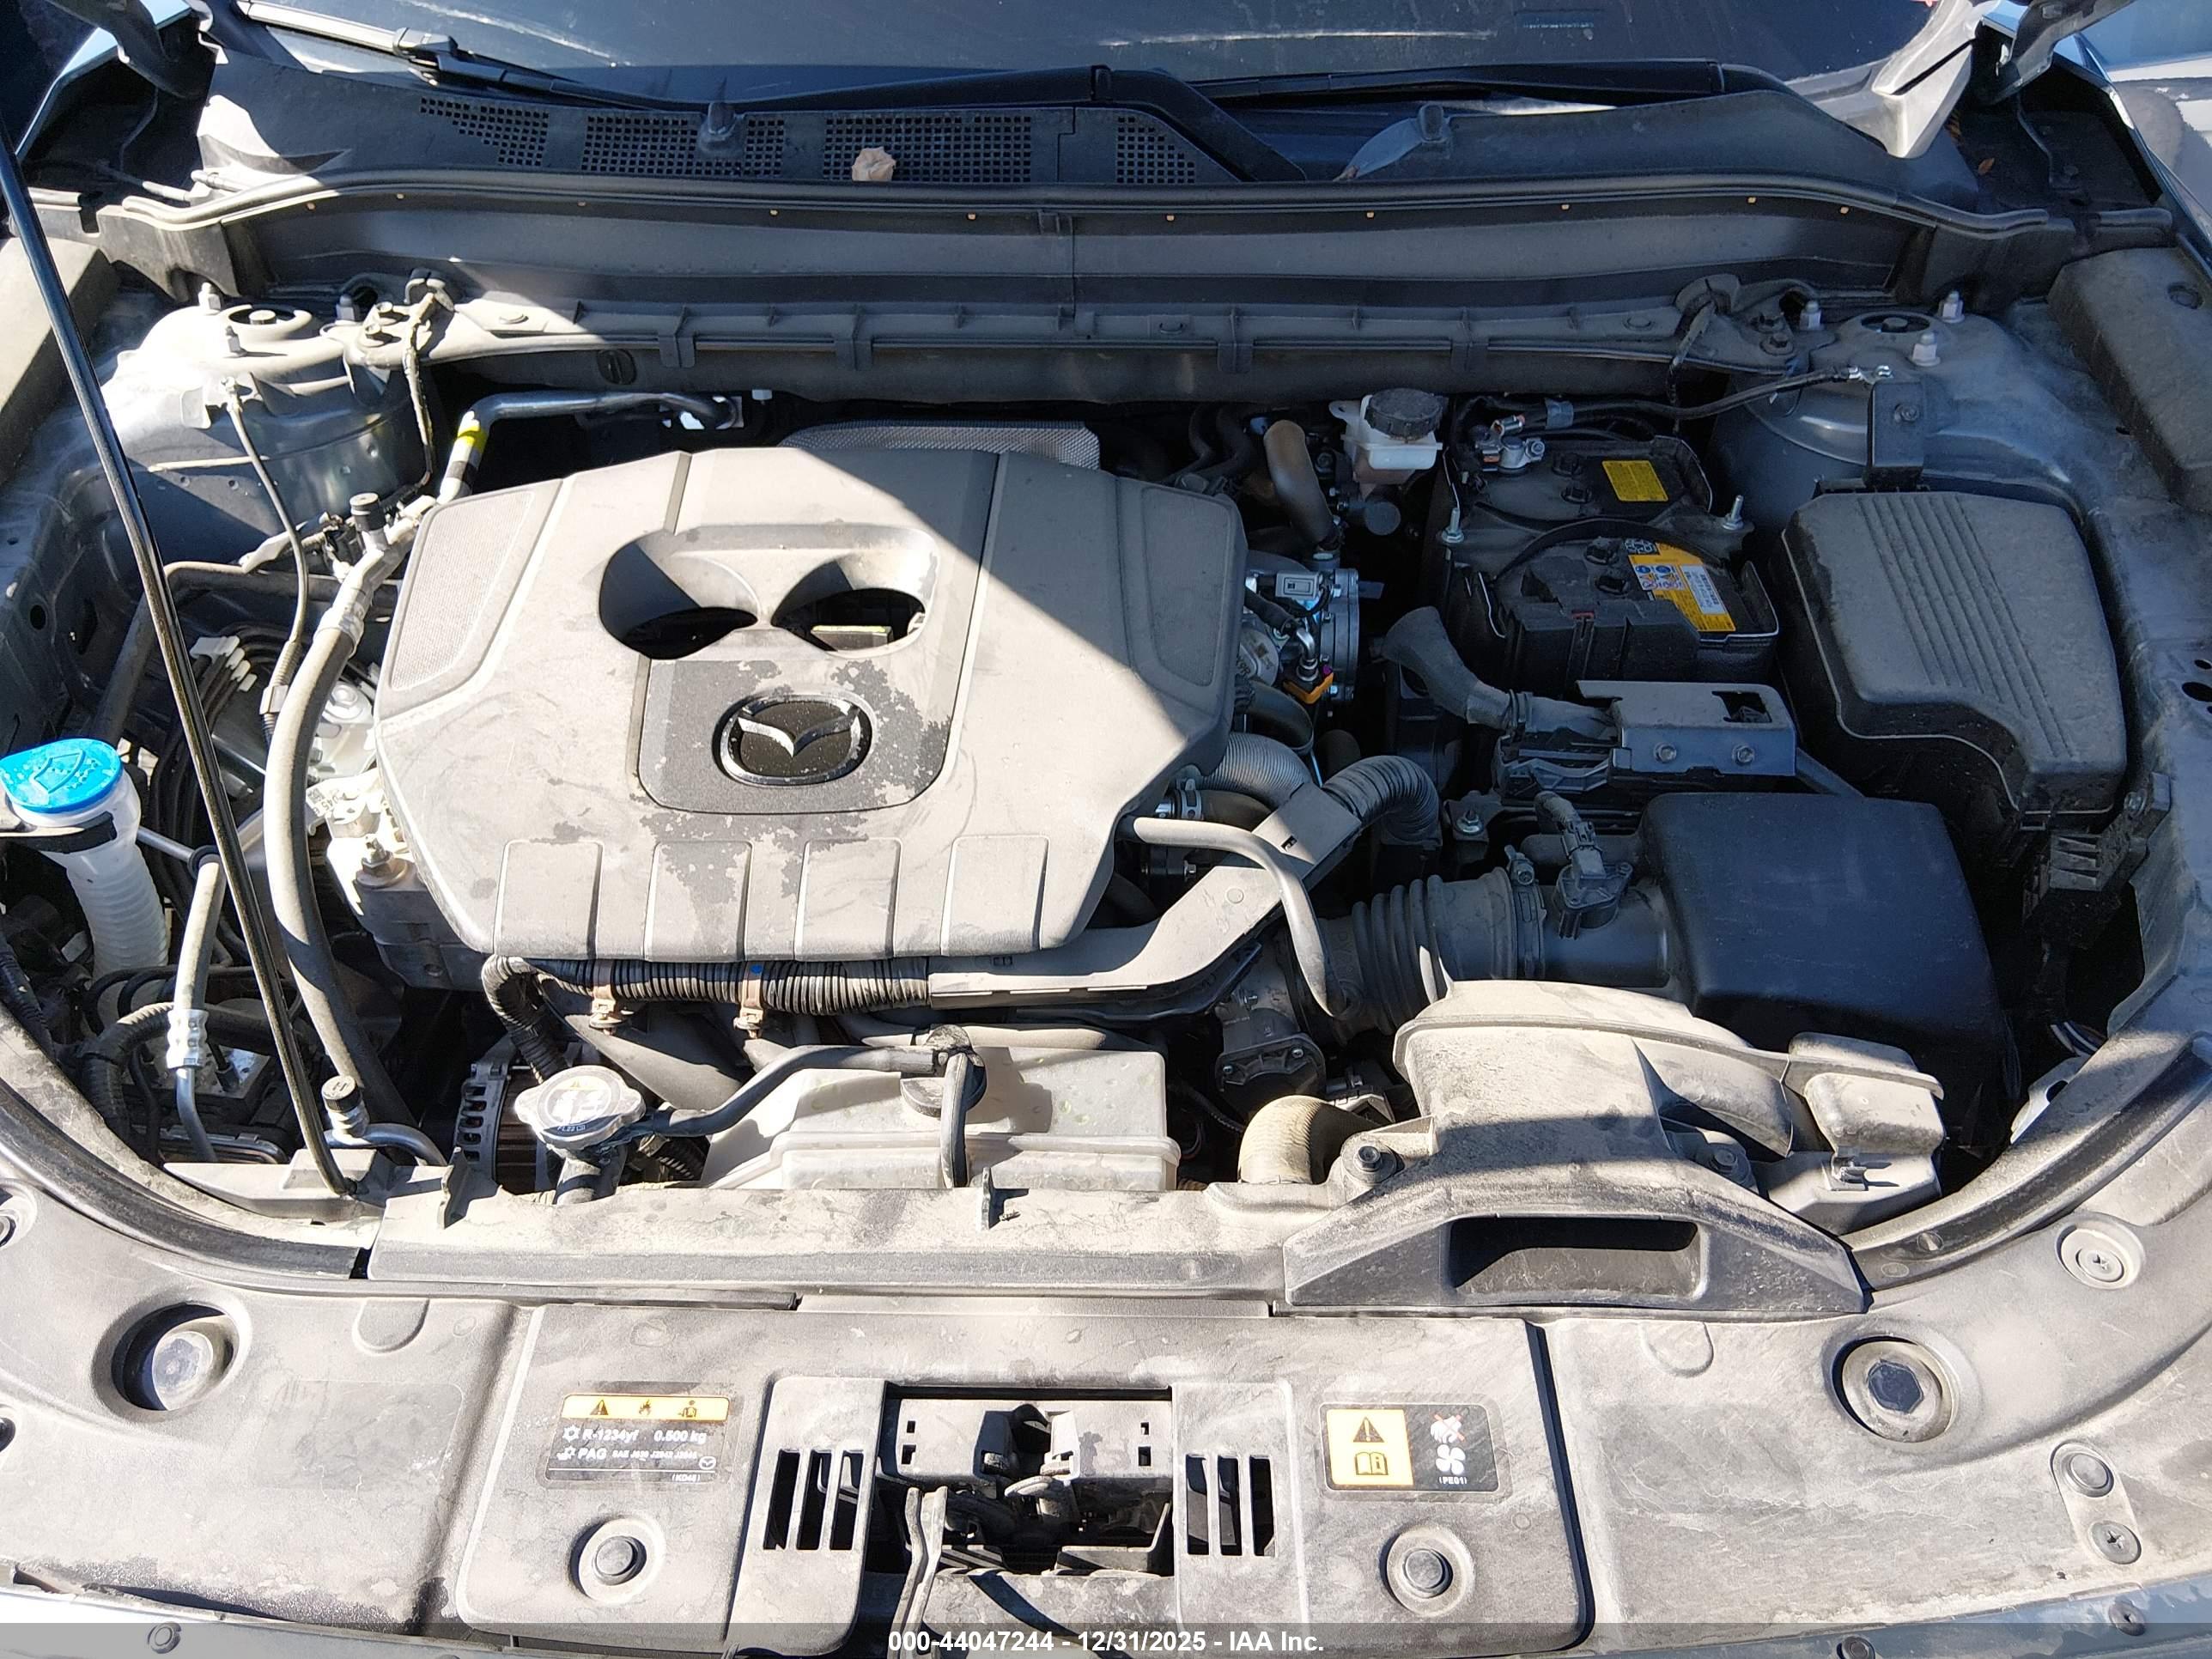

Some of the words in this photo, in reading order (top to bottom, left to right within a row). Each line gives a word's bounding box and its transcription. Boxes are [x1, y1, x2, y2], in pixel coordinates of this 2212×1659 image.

[582, 1428, 640, 1443] R-1234yf
[653, 1429, 689, 1443] 0.500
[690, 1430, 708, 1445] kg
[577, 1447, 607, 1461] PAG
[1438, 1476, 1468, 1485] (PE01)
